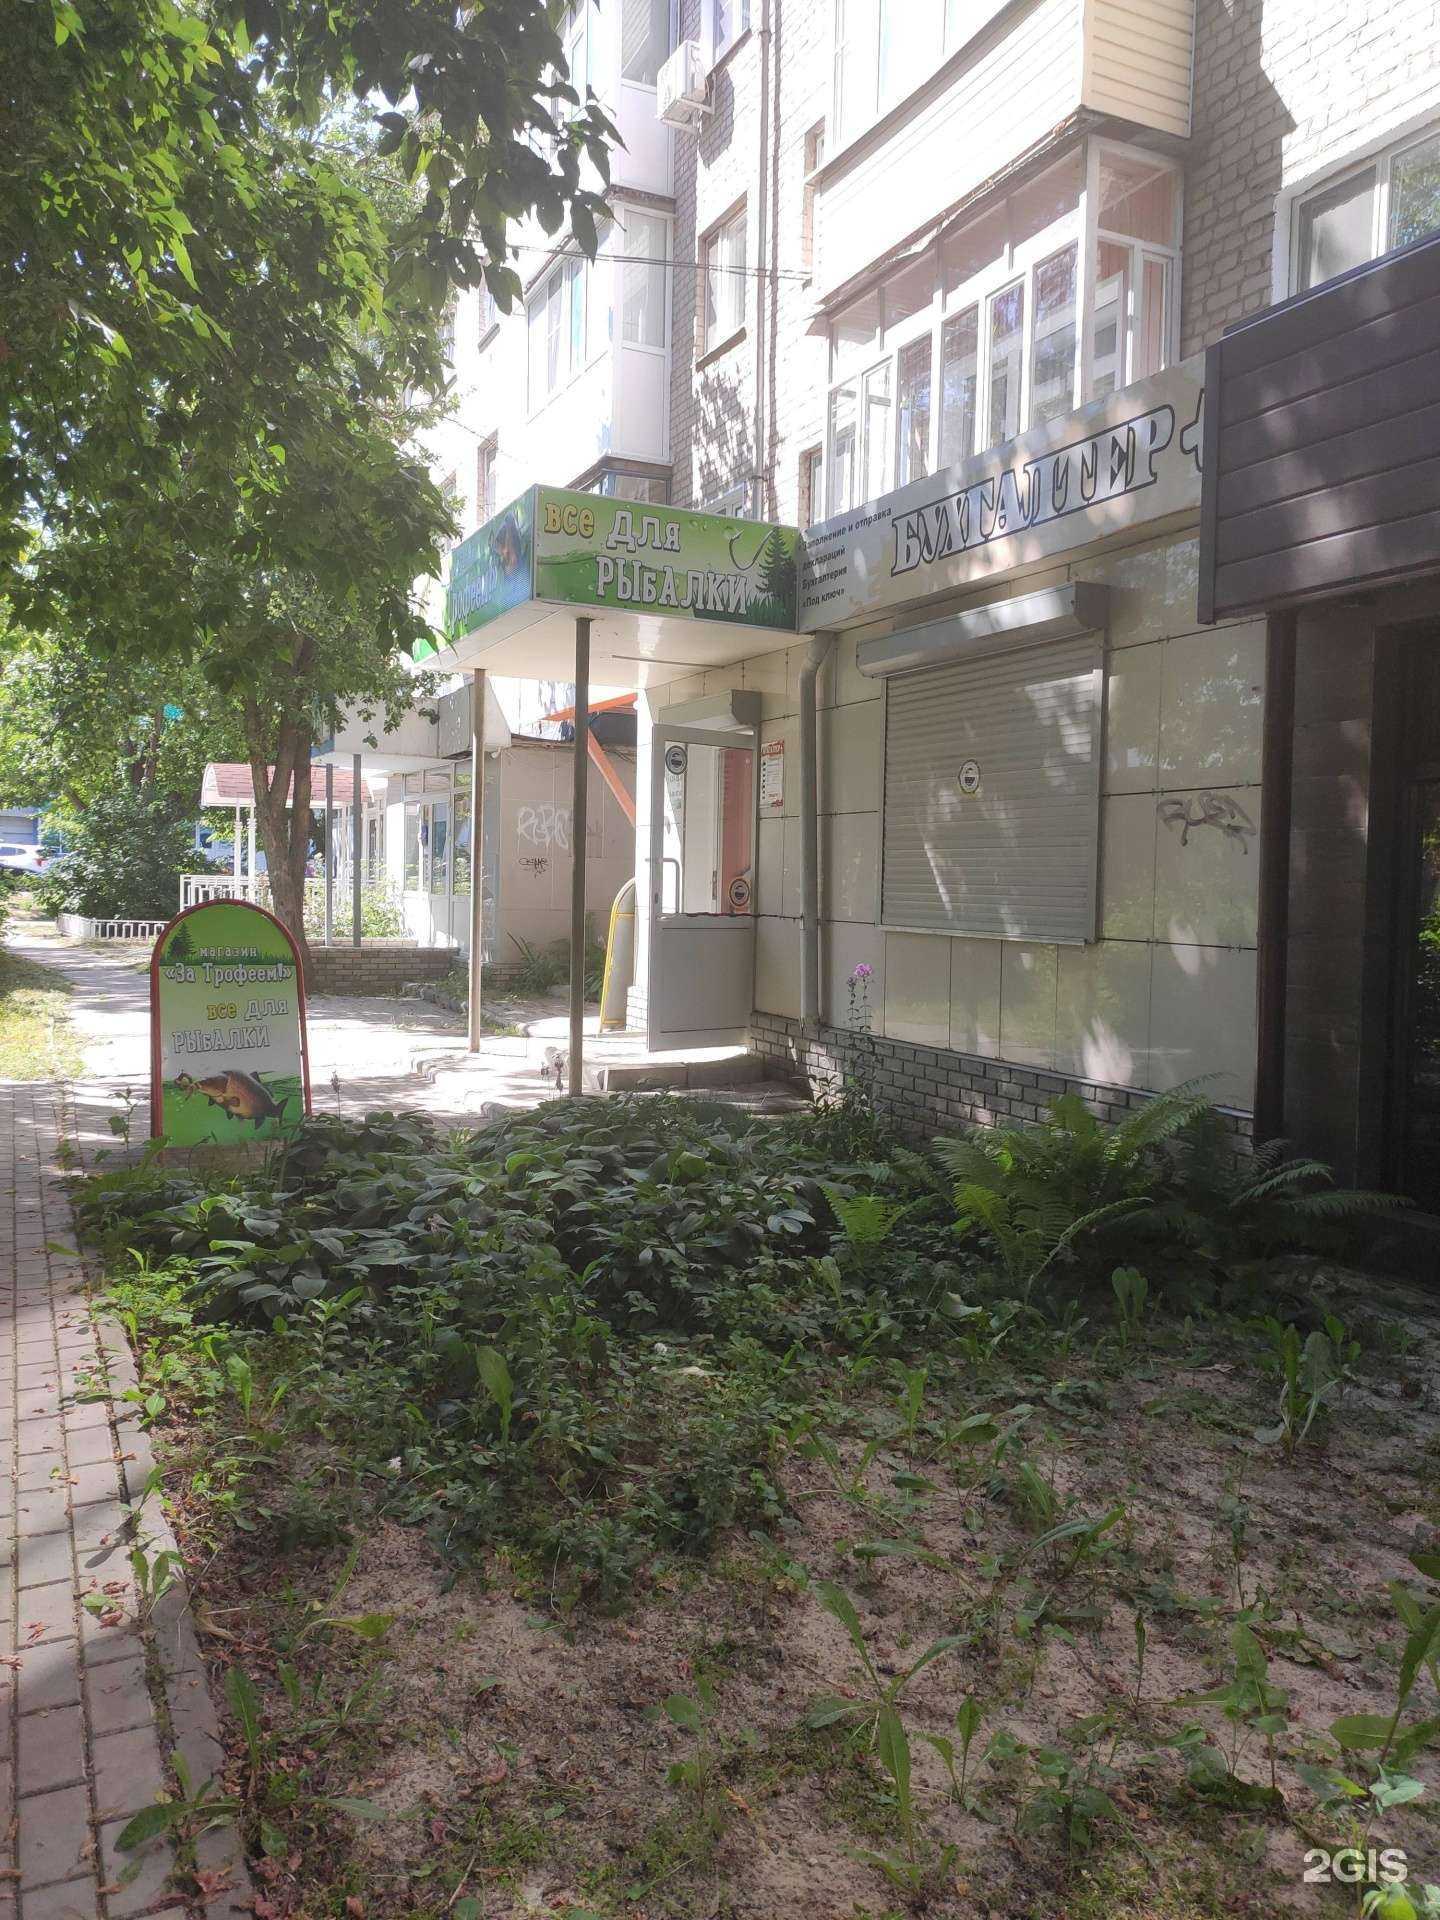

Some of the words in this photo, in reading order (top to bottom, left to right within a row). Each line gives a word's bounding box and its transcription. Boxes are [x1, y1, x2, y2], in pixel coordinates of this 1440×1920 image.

[848, 524, 853, 532] и
[855, 507, 892, 529] отправка
[802, 566, 847, 590] Бухгалтерия
[200, 947, 257, 957] магазин
[165, 963, 196, 983] «За
[202, 962, 291, 987] Трофеем!»
